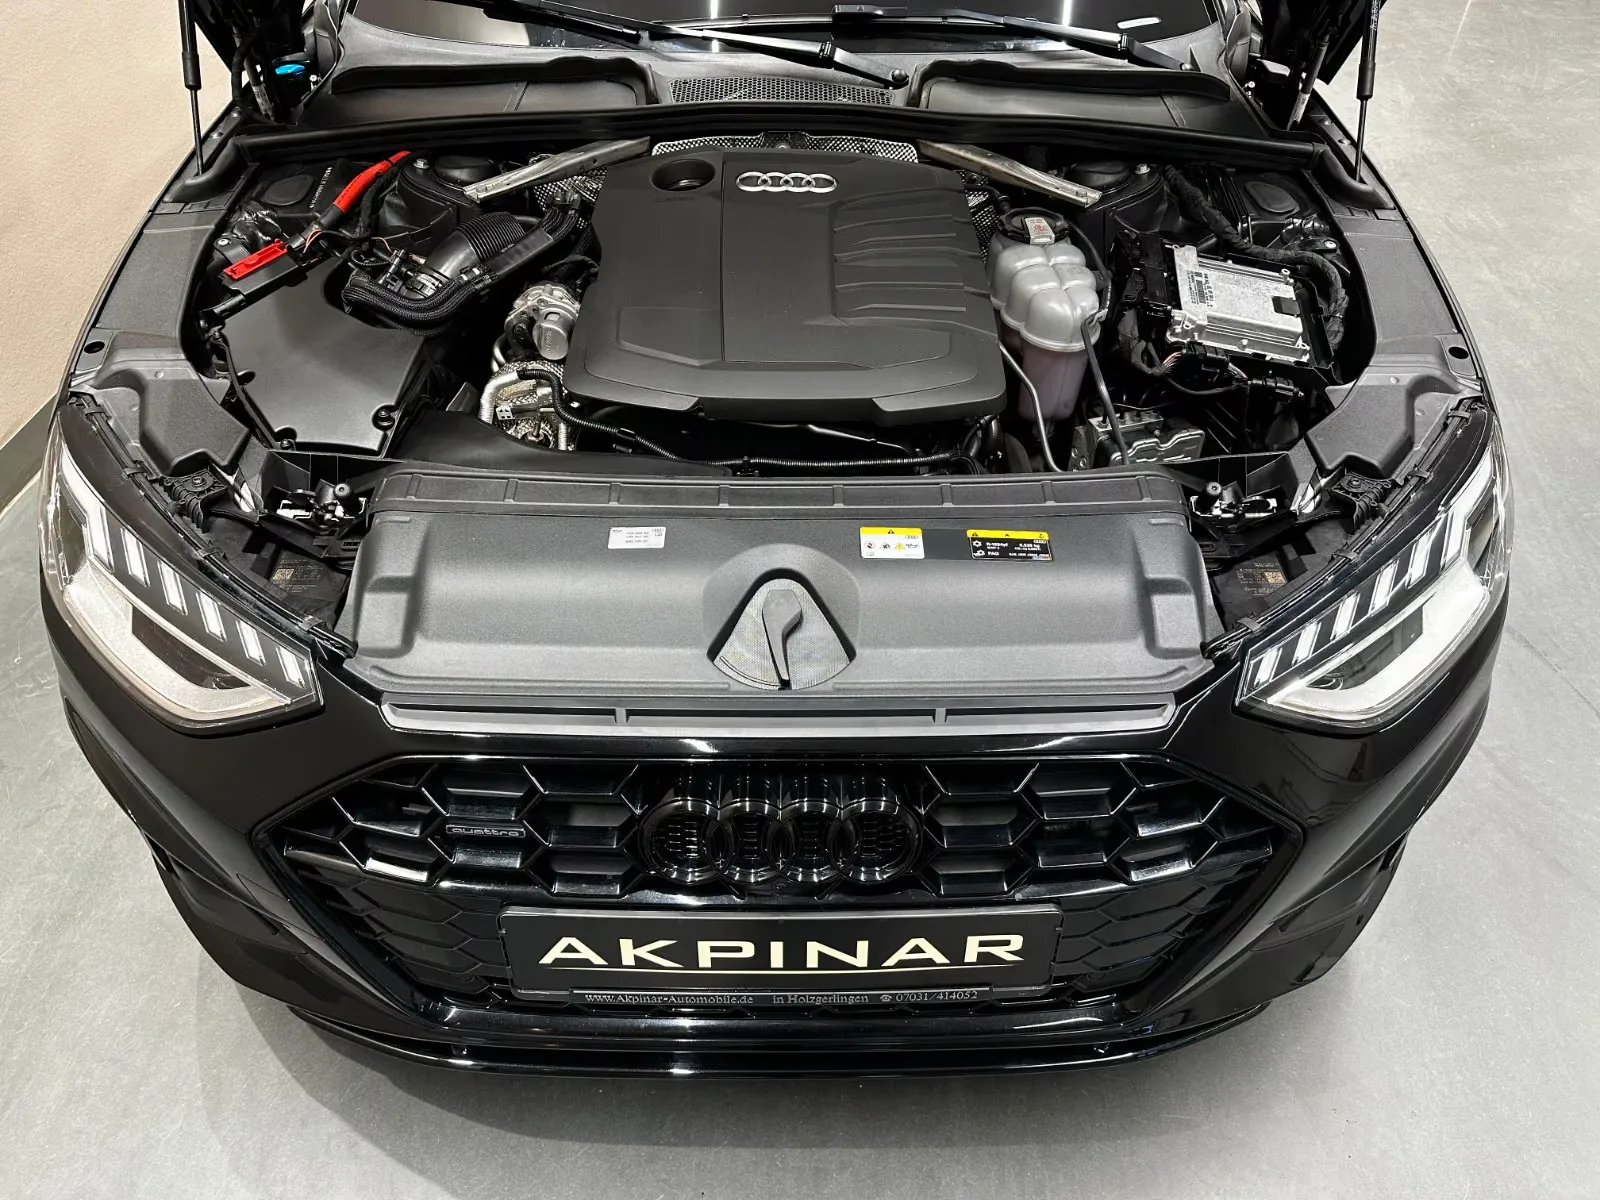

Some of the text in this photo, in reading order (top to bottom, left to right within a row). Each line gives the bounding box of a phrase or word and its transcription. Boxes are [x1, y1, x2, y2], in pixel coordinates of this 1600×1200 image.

[452, 828, 519, 837] quattro
[538, 934, 1025, 968] AKPINAR
[585, 991, 978, 1004] www.Akpinar-Automobile.de in Holzgerlingen 07031/414052
